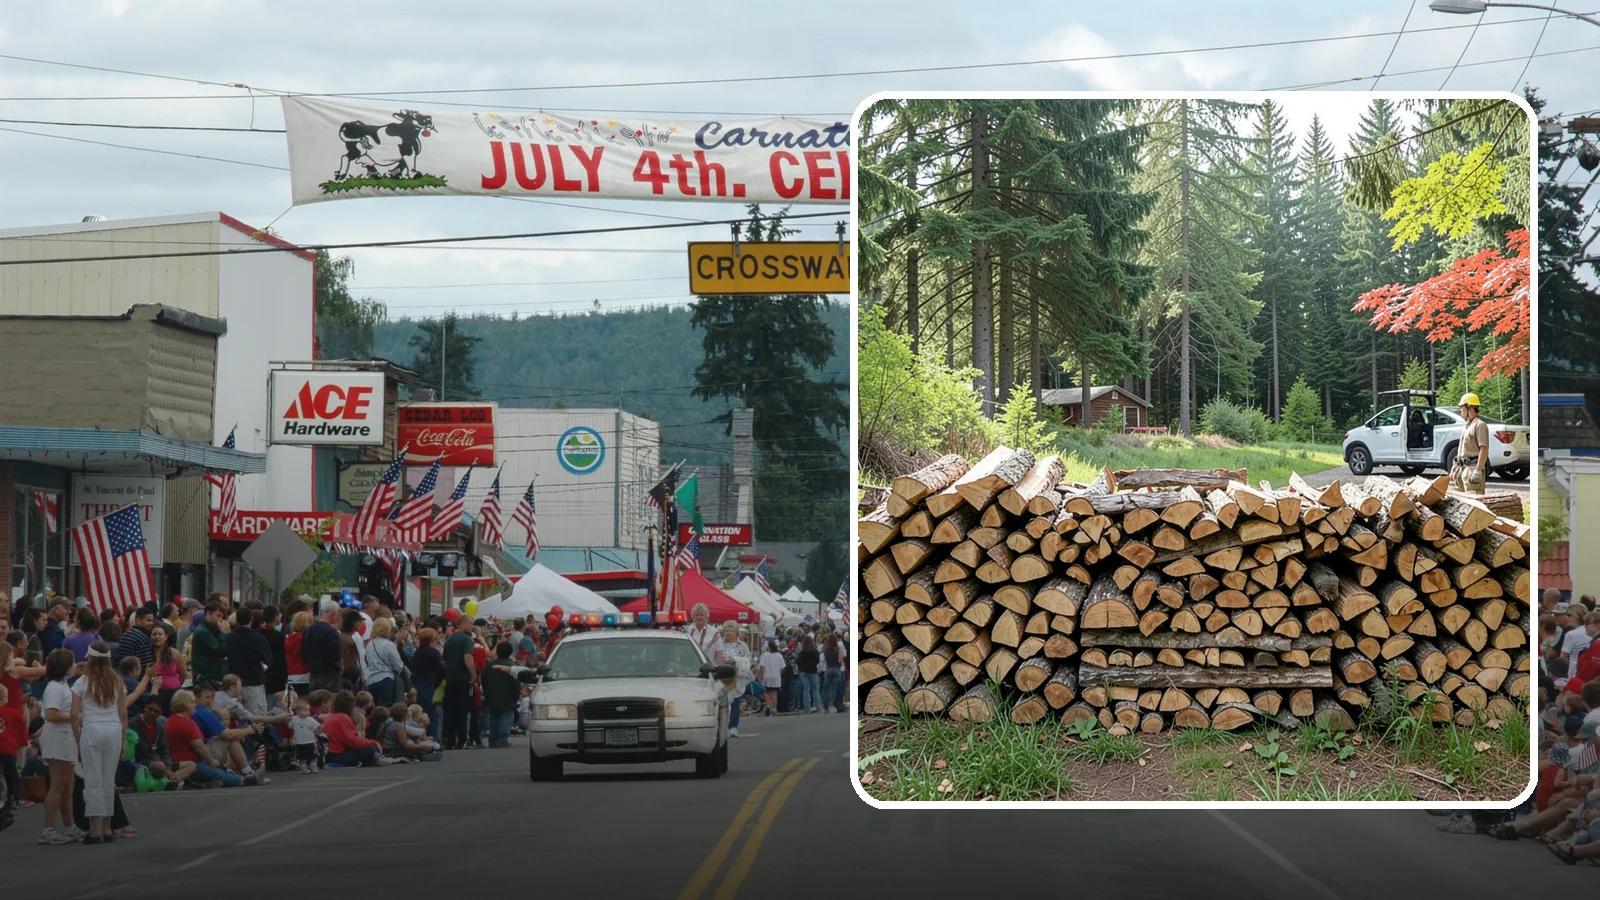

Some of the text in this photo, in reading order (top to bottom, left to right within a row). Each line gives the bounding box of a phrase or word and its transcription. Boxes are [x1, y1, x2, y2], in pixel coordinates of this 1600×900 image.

[694, 121, 850, 150] Carnat
[481, 141, 605, 192] JULY
[632, 150, 746, 198] 4th.
[697, 254, 850, 280] CROSSWA
[282, 380, 374, 420] ACE
[405, 409, 452, 422] CEDAR
[283, 421, 371, 436] Hardware
[416, 428, 477, 447] Coca-Cola
[83, 485, 155, 495] St. Vincent de Paul
[212, 516, 330, 536] HARDARE
[688, 526, 741, 535] CRNATION
[699, 535, 730, 543] GLASS
